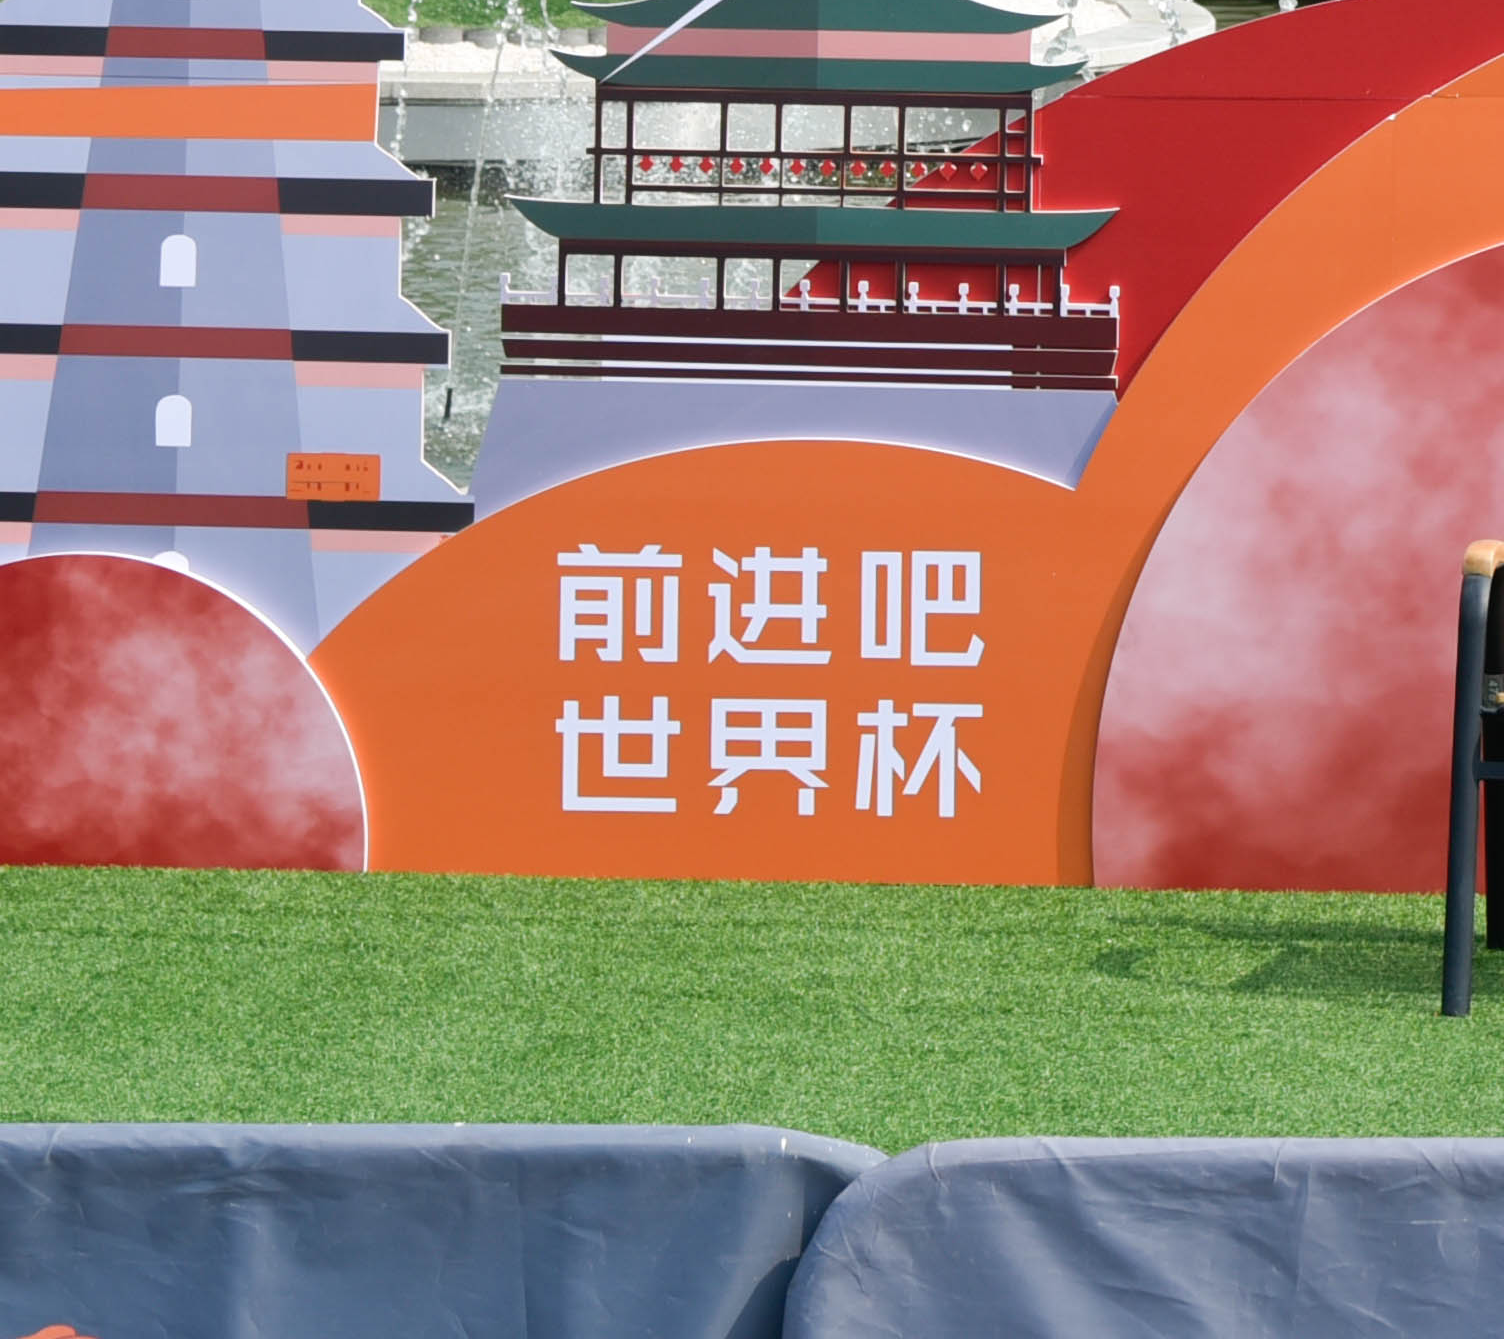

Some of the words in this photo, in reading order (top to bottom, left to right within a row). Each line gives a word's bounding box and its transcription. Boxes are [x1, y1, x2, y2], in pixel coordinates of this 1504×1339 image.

[556, 543, 985, 667] 前进吧
[554, 694, 984, 818] 世界杯
